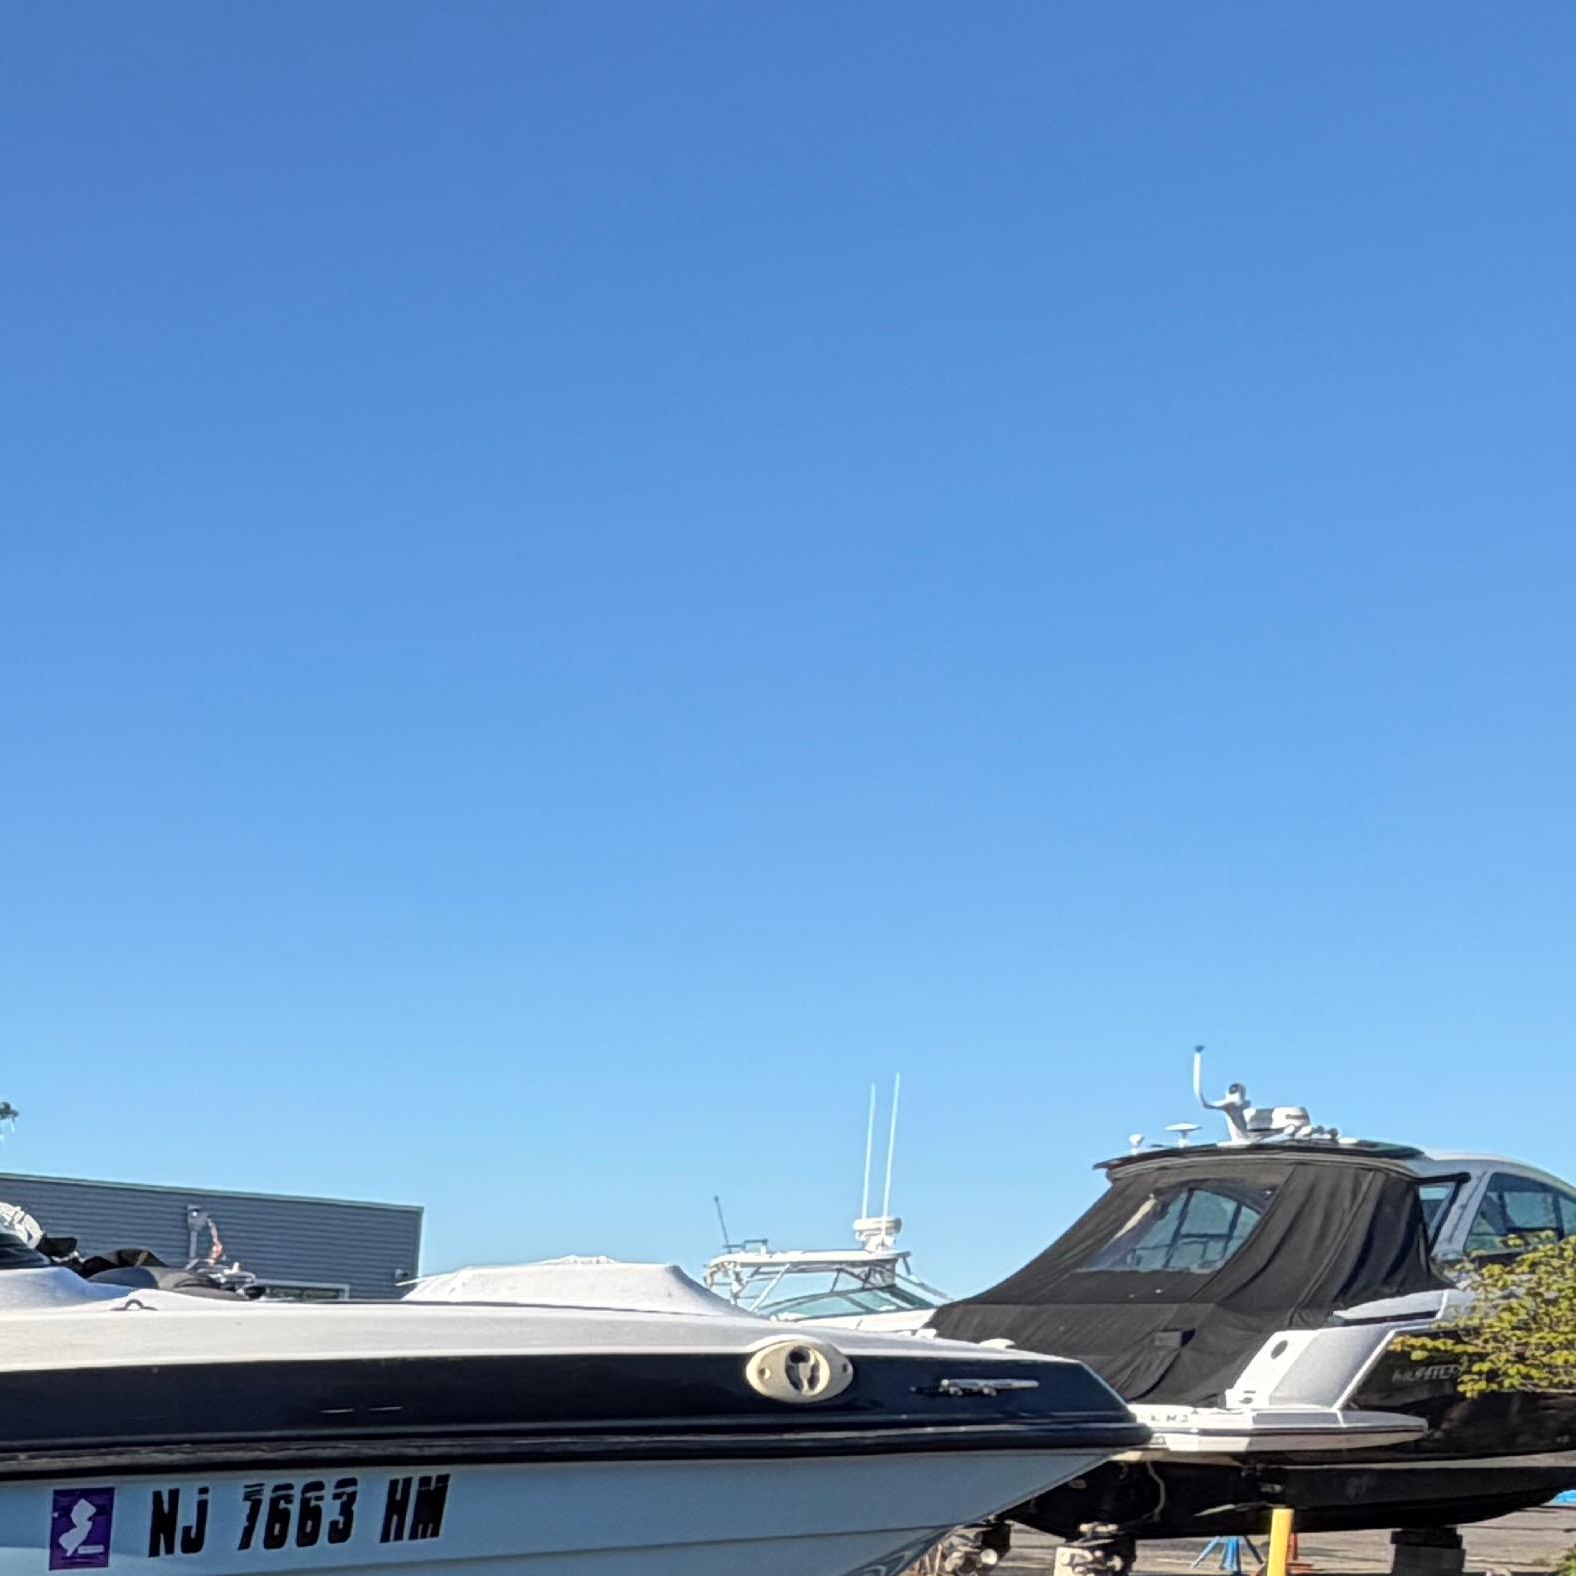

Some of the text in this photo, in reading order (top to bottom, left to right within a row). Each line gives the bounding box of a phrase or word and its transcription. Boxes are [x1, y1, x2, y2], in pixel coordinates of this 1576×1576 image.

[148, 1473, 451, 1558] NJ 7663 HM
